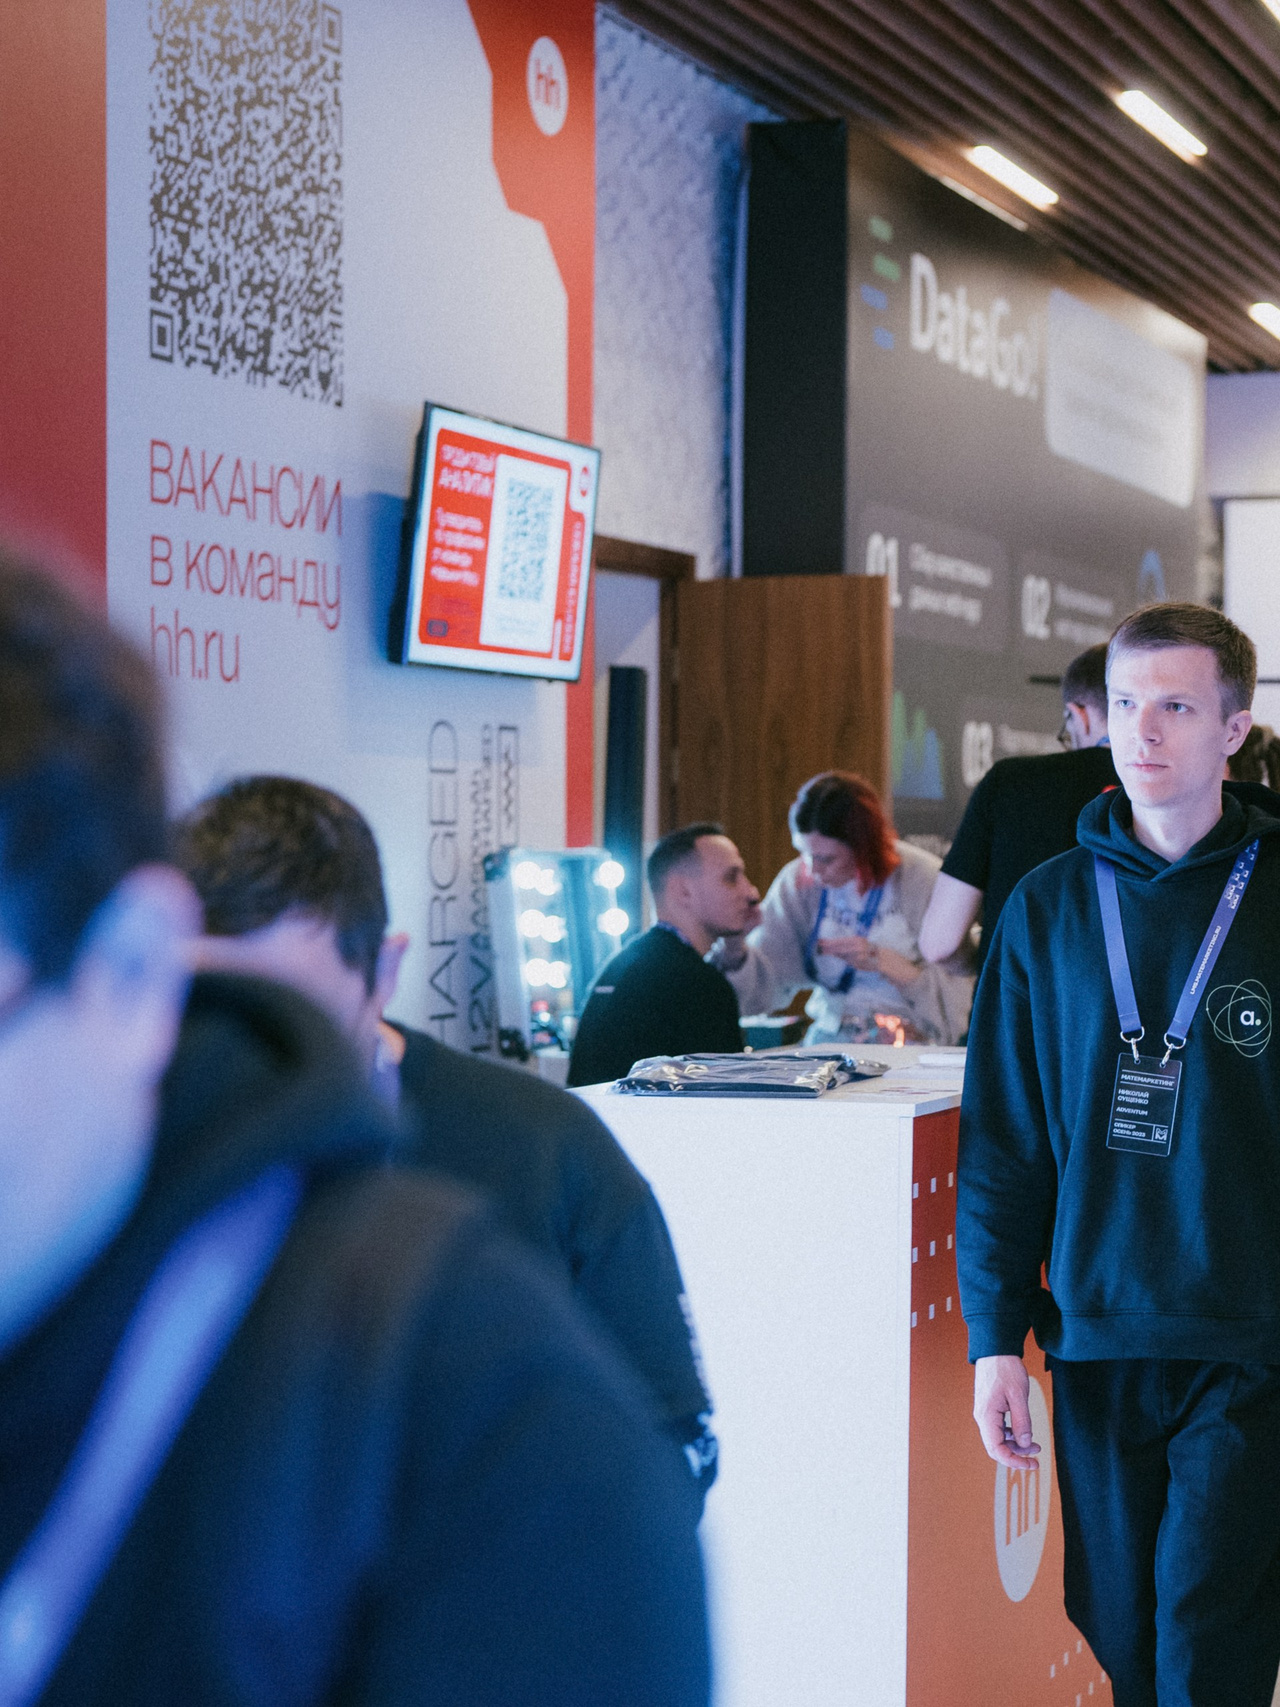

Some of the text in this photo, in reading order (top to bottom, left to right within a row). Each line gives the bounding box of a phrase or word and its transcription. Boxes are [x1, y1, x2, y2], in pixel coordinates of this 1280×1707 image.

[535, 57, 560, 112] hh
[150, 438, 342, 537] ВАКАНСИИ
[185, 540, 341, 631] команду
[151, 605, 240, 682] hh.ru
[1118, 1089, 1149, 1098] НИКОЛАЙ
[1121, 1074, 1174, 1086] МАТЕМАРКЕТИНГ
[1116, 1106, 1148, 1115] ADVENTUM
